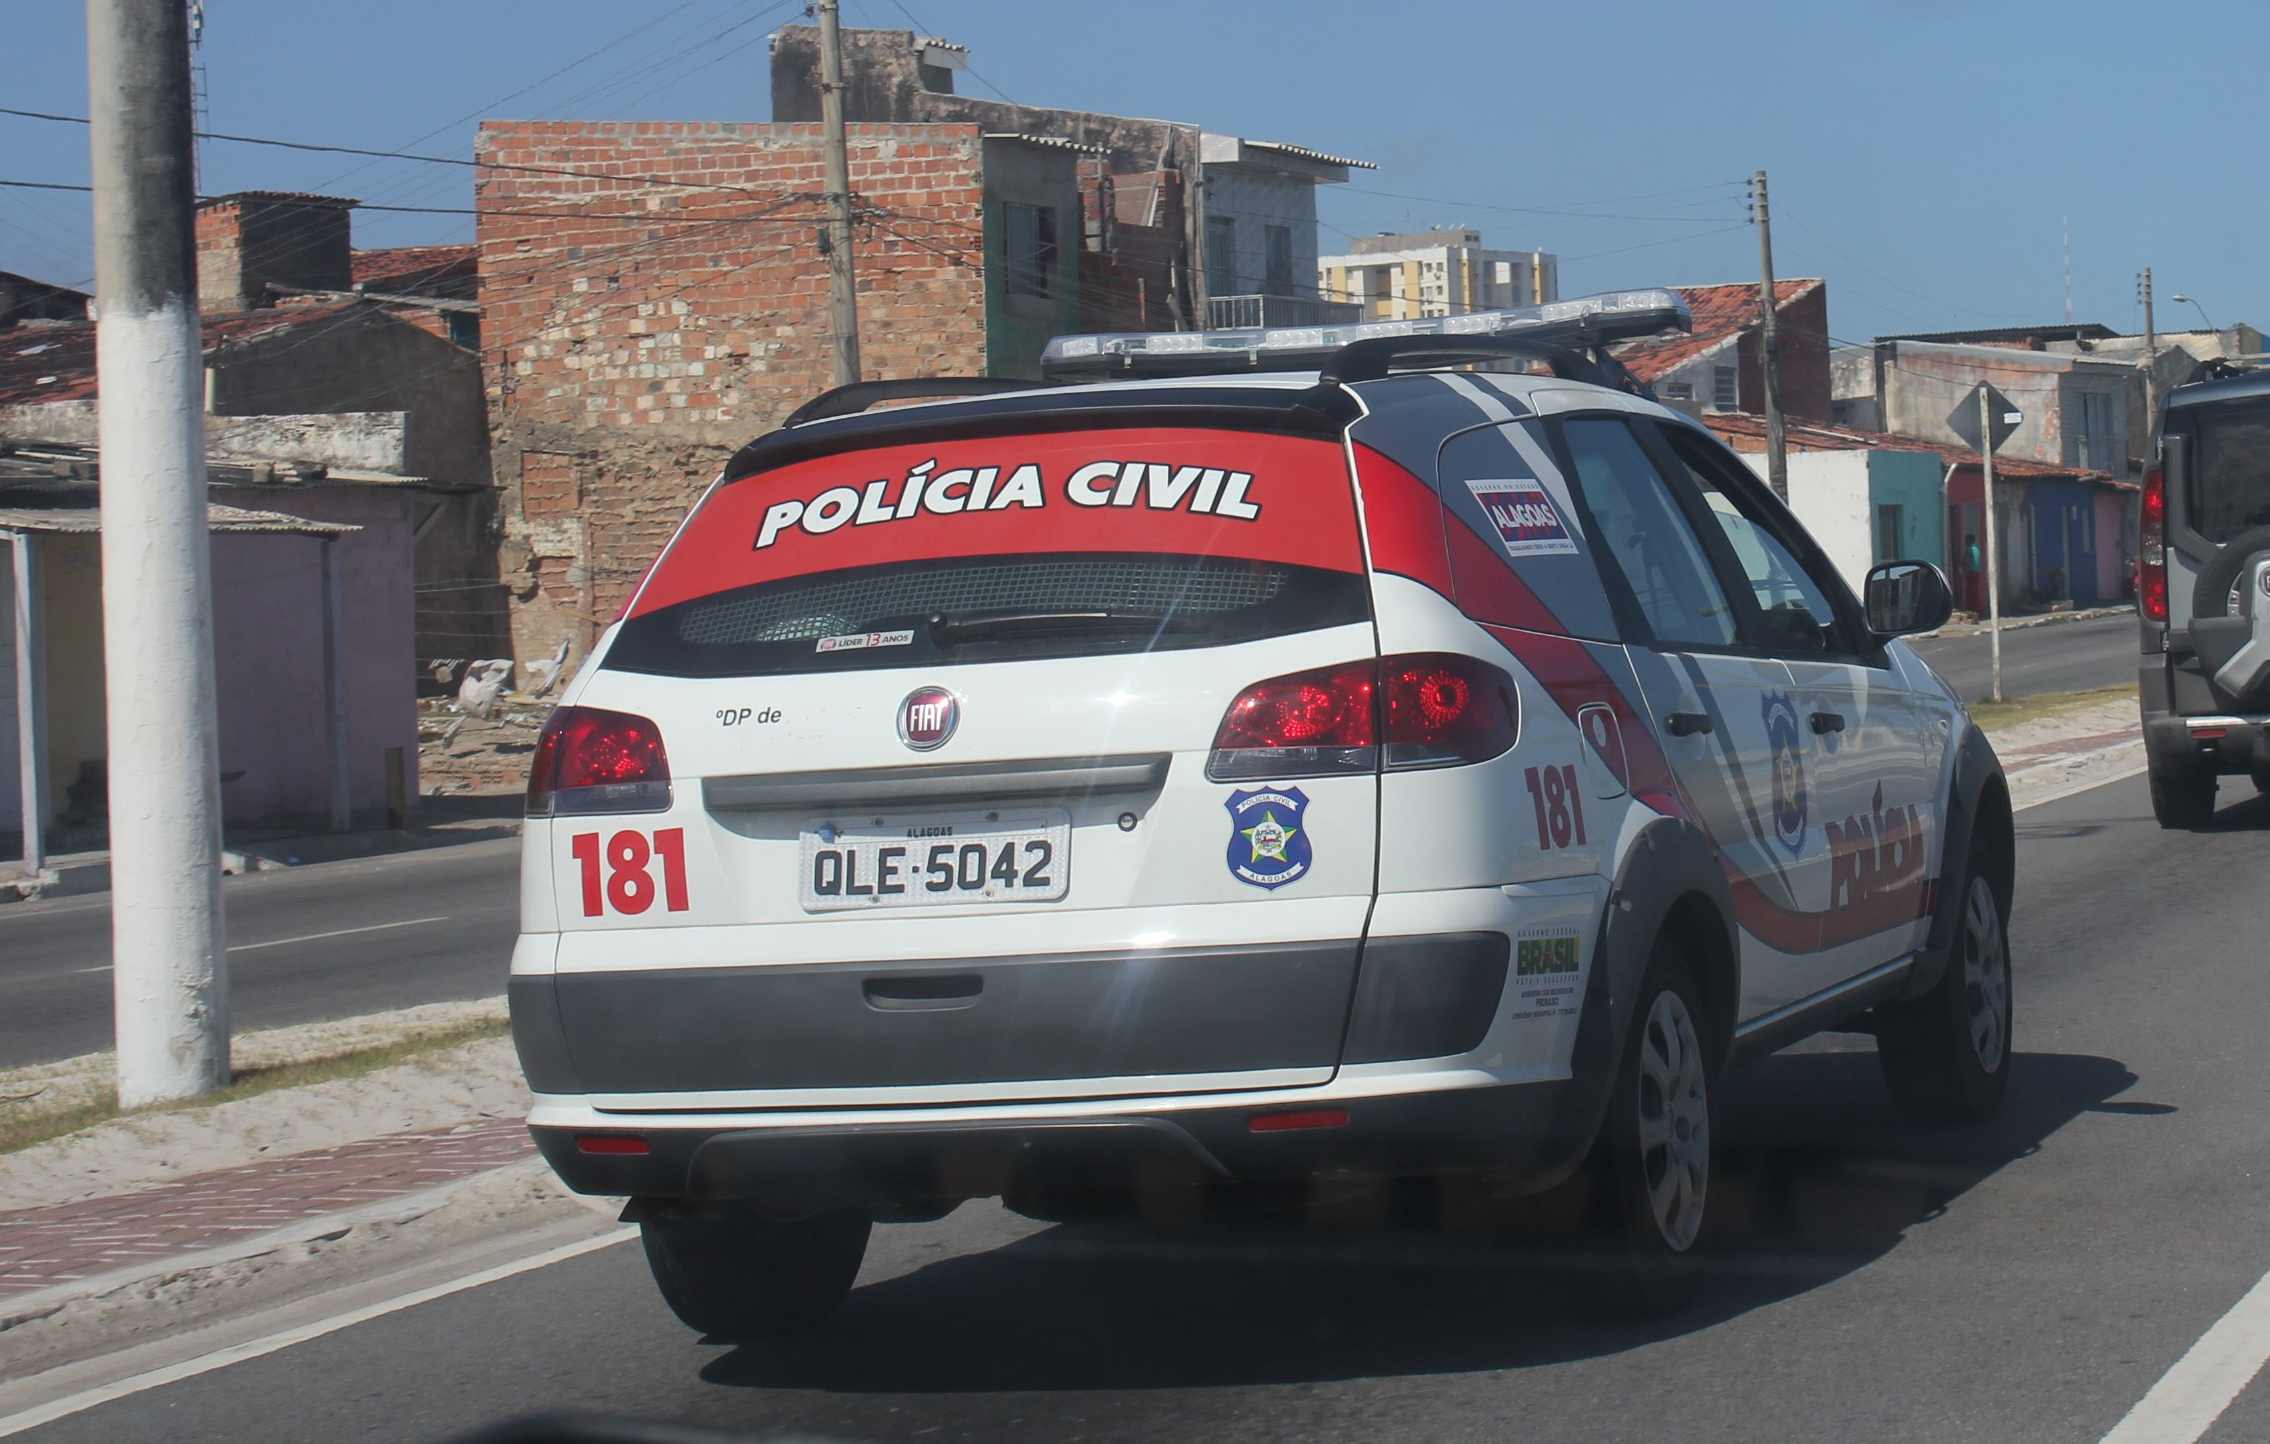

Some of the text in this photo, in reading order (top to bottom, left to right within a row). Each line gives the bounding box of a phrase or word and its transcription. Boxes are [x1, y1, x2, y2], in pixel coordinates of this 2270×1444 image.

[754, 458, 1262, 549] POLÍCIA CIVIL
[1491, 503, 1558, 529] ALAGOAS
[865, 633, 880, 647] 13
[882, 635, 910, 644] ANOS
[757, 706, 783, 724] de
[910, 703, 946, 732] FIAT
[1524, 764, 1587, 850] 181
[907, 825, 953, 838] ALAGOAS
[571, 826, 690, 917] 181
[1249, 871, 1292, 882] ALAGOAS
[1517, 935, 1580, 977] BRASIL
